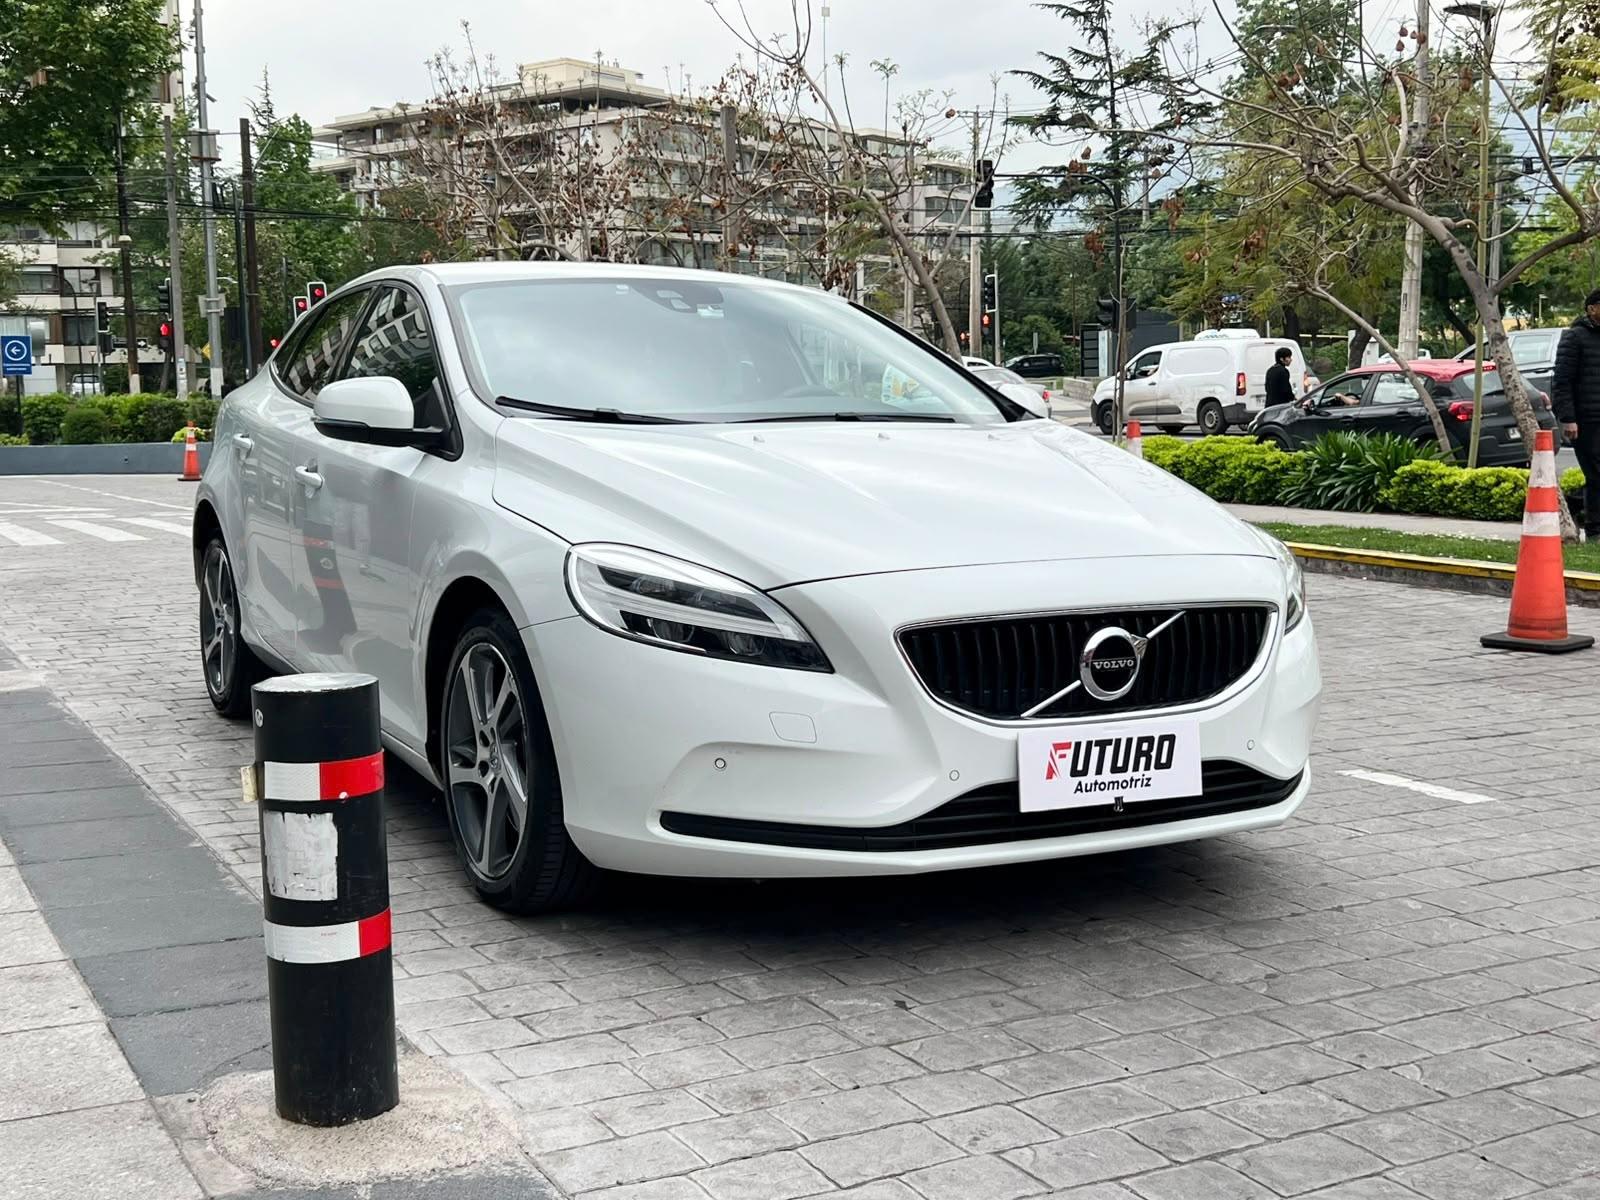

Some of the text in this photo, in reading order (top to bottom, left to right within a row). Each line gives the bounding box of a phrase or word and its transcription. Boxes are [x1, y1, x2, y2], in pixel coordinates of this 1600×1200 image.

[1093, 659, 1134, 669] VOLVO
[1046, 734, 1176, 780] FUTURO
[1074, 774, 1152, 794] Automotriz
